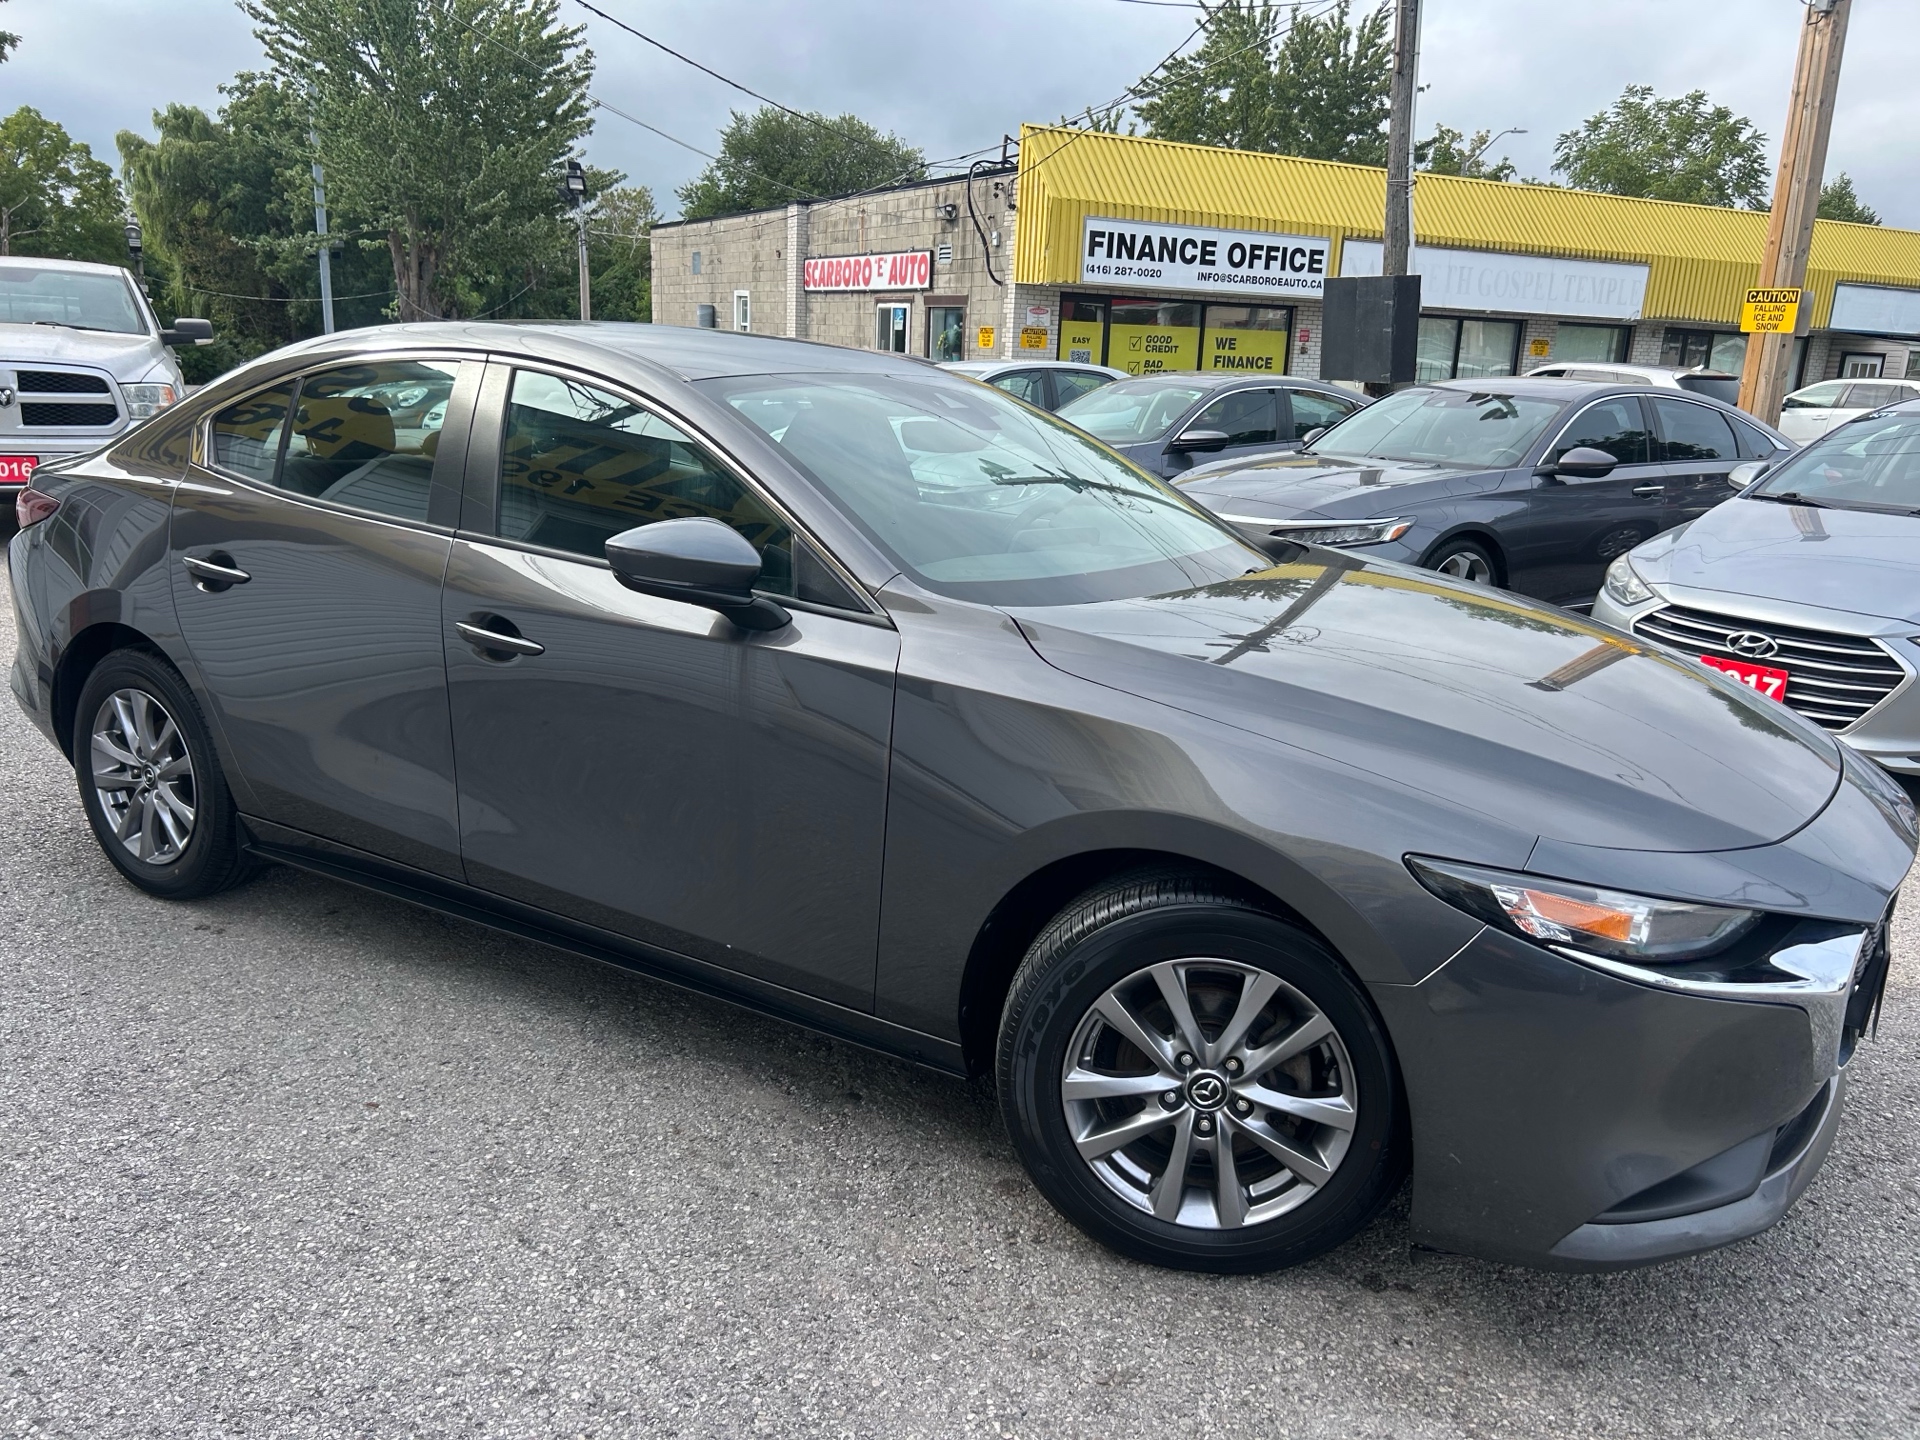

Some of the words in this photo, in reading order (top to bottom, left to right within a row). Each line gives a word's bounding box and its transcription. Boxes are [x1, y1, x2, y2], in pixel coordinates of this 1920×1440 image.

[1087, 230, 1217, 266] FINANCE
[1227, 242, 1325, 274] OFFICE
[805, 257, 872, 288] SCARBORO
[888, 254, 929, 286] AUTO
[1086, 264, 1111, 275] (416)
[1114, 266, 1162, 278] 287-0020
[1197, 272, 1322, 289] INFO@SCARBOROEAUTO.CA
[1478, 267, 1558, 302] GOSPEL
[1564, 273, 1642, 307] TEMPLE
[1749, 291, 1797, 302] CAUTION
[1754, 304, 1786, 312] FALLING
[1753, 313, 1766, 321] ICE
[1767, 313, 1784, 321] AND
[1755, 322, 1779, 330] SNOW
[1146, 335, 1172, 344] GOOD
[1215, 337, 1236, 350] WE
[1145, 345, 1179, 353] CREDIT
[1144, 360, 1163, 368] BAD
[1213, 355, 1273, 369] FINANCE
